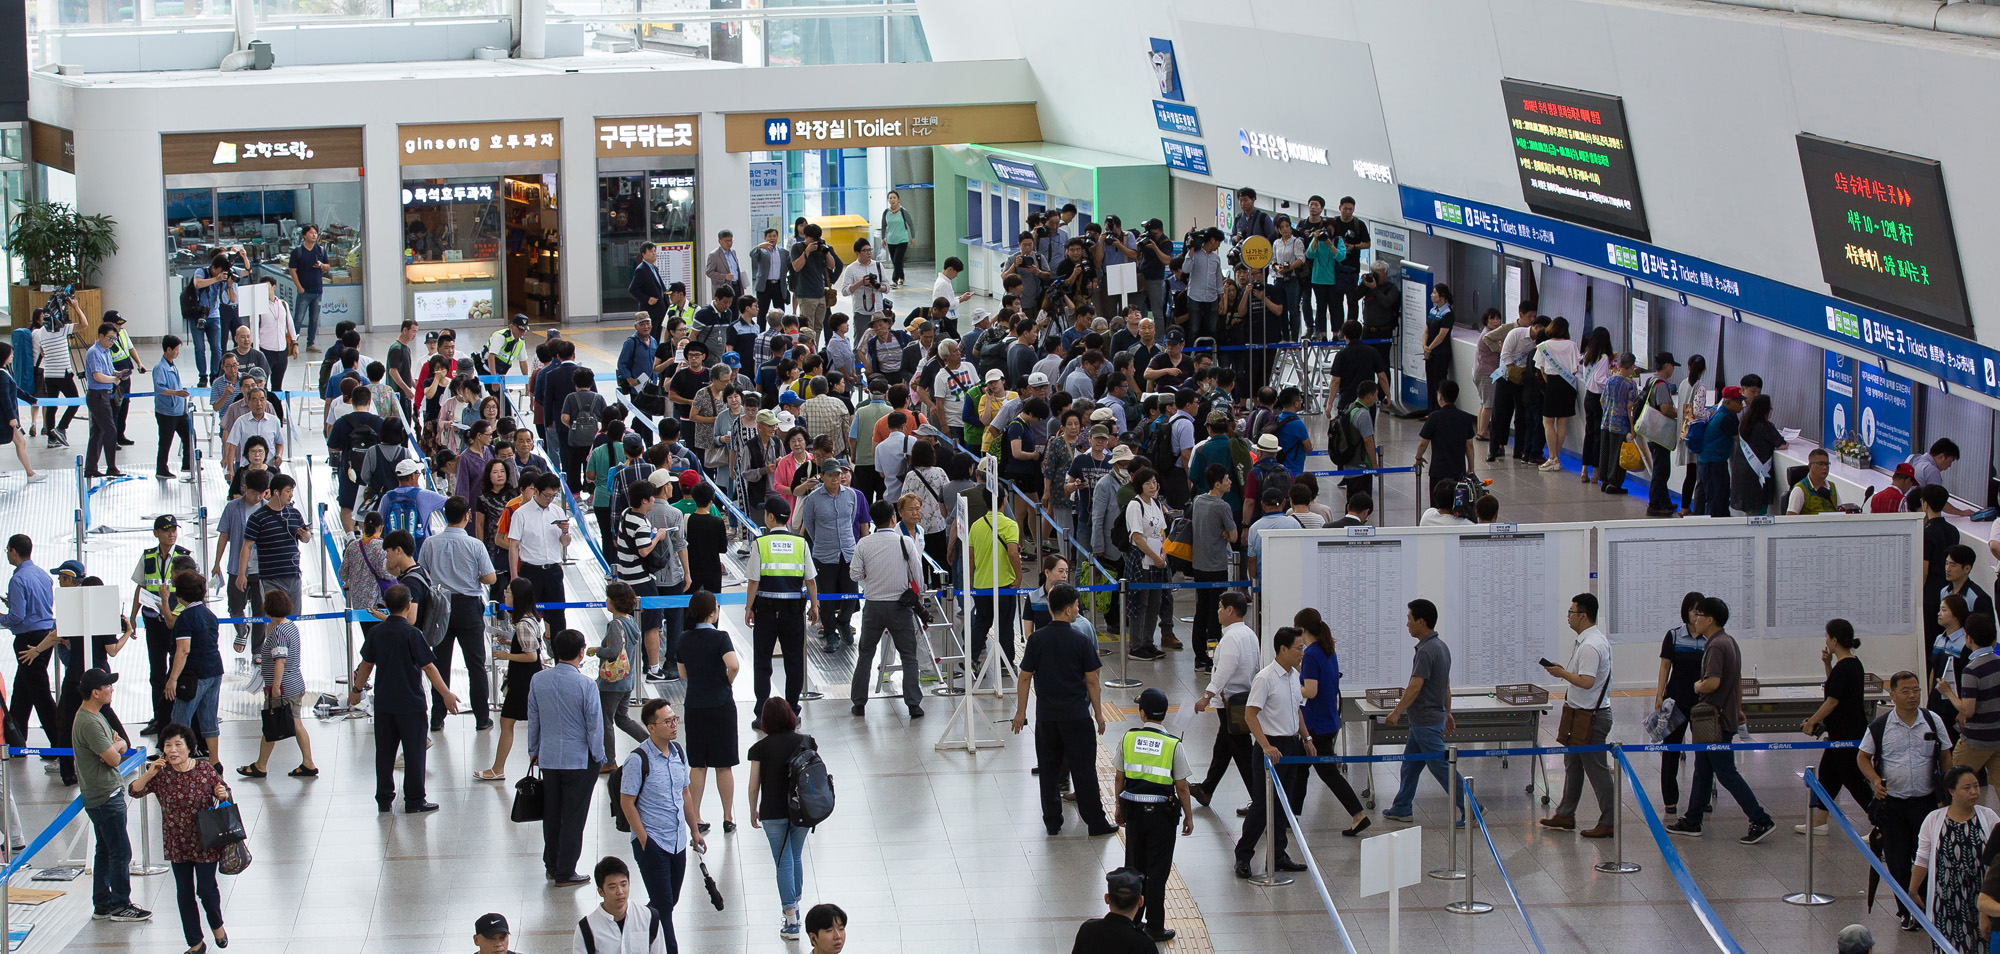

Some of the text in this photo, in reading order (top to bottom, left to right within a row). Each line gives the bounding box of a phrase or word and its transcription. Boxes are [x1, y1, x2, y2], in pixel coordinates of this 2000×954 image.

[489, 132, 555, 150] 호두과자
[600, 123, 693, 150] 구두닦는곳
[795, 116, 939, 140] 화장실 Toilet 卫生间
[1249, 131, 1290, 163] 우리은행
[1309, 145, 1329, 165] BANK
[650, 176, 693, 188] 구두닦는곳
[764, 168, 777, 178] 구역
[1834, 171, 1897, 204] 오늘 승차권 사는 곳
[1473, 208, 1492, 231] 표사는
[1491, 213, 1500, 233] 곳
[1499, 218, 1517, 236] Tickets
[1847, 209, 1861, 233] 서부
[1862, 215, 1873, 234] 10
[1880, 219, 1899, 242] 12번
[1898, 223, 1914, 247] 창구
[1650, 254, 1670, 279] 표사는
[1670, 258, 1679, 281] 곳
[1679, 265, 1699, 284] Tickets
[1883, 255, 1896, 276] 3층
[1896, 259, 1920, 283] 표사는
[1920, 265, 1930, 285] 곳
[1873, 321, 1896, 351] 표사는
[1896, 329, 1906, 355] 곳
[1906, 336, 1929, 359] Tickets
[1137, 738, 1161, 748] 철도경찰
